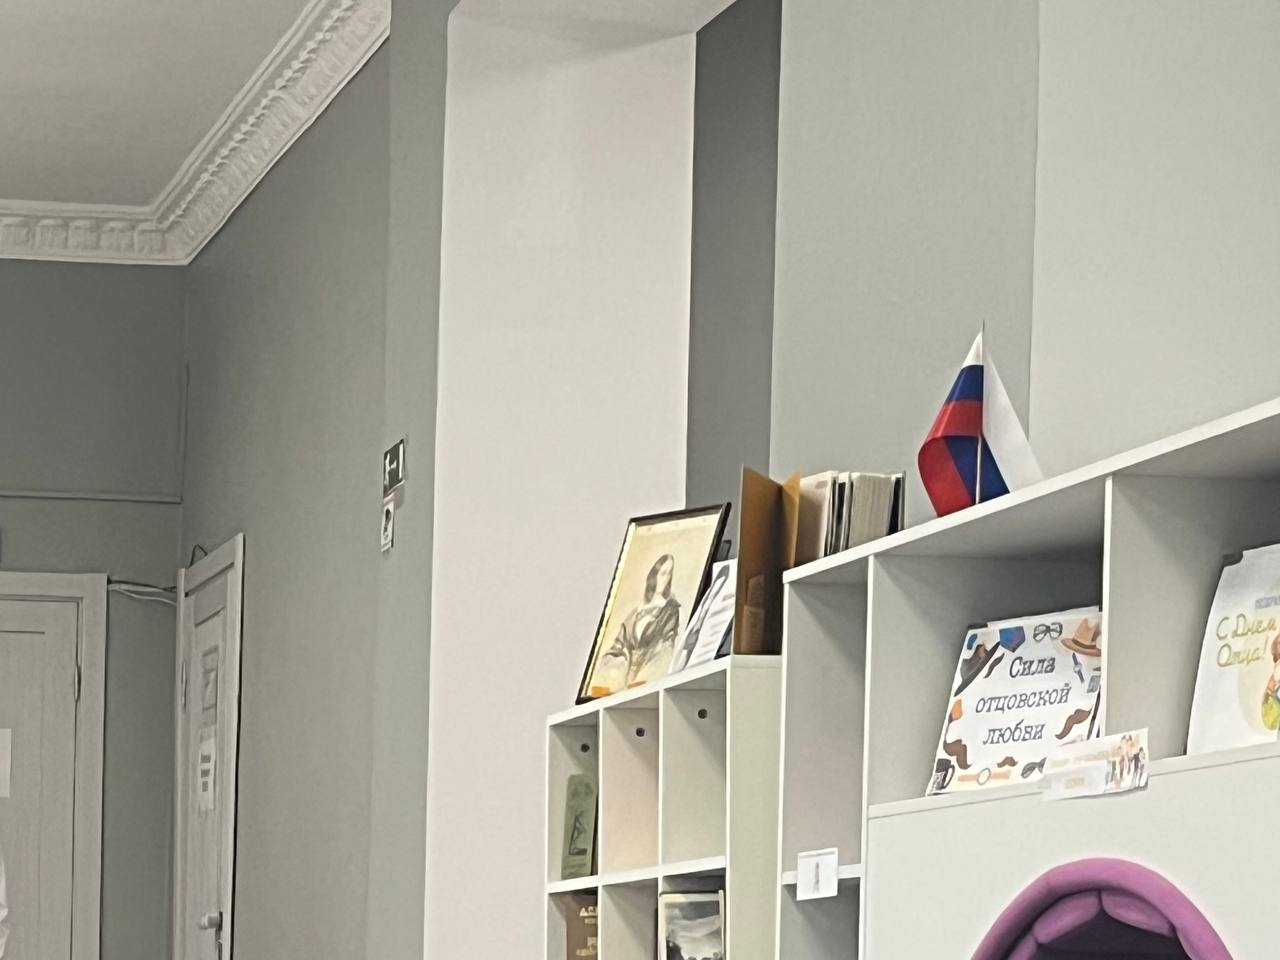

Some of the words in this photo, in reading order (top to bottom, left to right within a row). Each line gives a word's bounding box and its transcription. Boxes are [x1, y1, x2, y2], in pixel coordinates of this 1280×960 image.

[1216, 616, 1231, 641] С
[1231, 612, 1278, 640] Днем
[1009, 655, 1056, 678] Сила
[1216, 642, 1269, 668] Отца!
[975, 682, 1072, 713] отцовской
[982, 719, 1045, 746] любви
